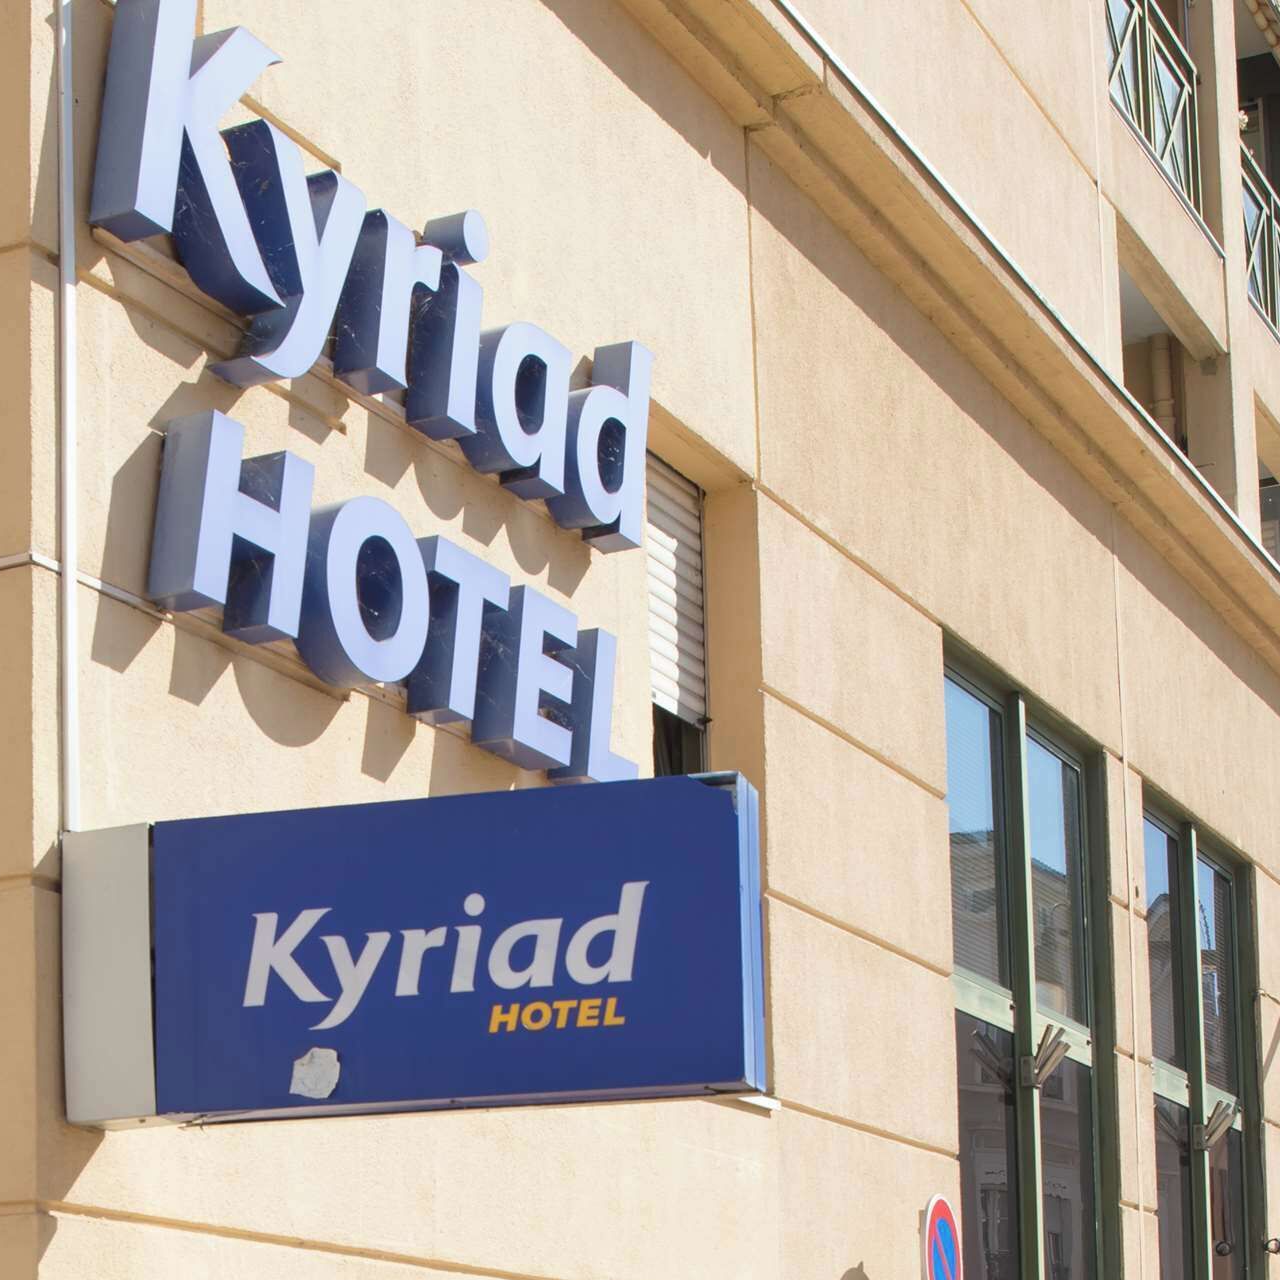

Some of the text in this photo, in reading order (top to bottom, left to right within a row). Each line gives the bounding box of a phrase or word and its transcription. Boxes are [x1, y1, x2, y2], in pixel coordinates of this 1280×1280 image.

[90, 0, 654, 552] Kyriad
[148, 409, 639, 782] HOTEL
[242, 880, 650, 1030] Kyriad
[487, 996, 626, 1033] HOTEL
